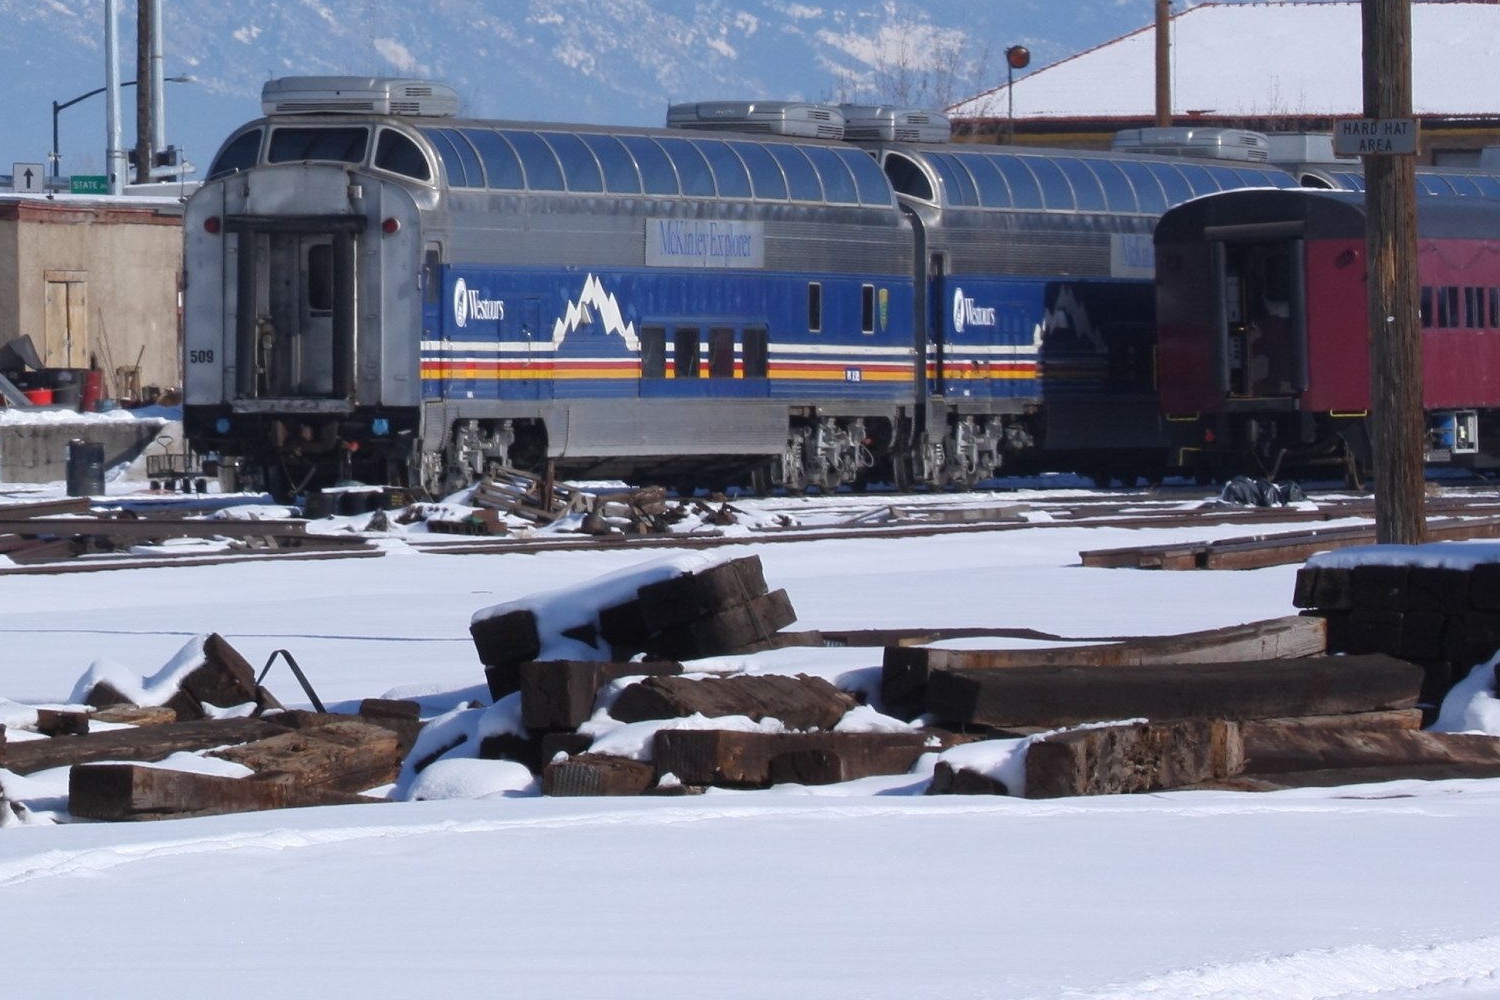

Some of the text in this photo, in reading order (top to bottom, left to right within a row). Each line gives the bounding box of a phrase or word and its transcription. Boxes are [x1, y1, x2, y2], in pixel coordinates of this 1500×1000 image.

[1343, 122, 1408, 136] HARD HAT
[1359, 138, 1393, 152] AREA
[72, 181, 98, 190] STATE
[660, 220, 752, 267] McKinley Explorer
[468, 289, 504, 320] Westours
[190, 350, 214, 363] 509
